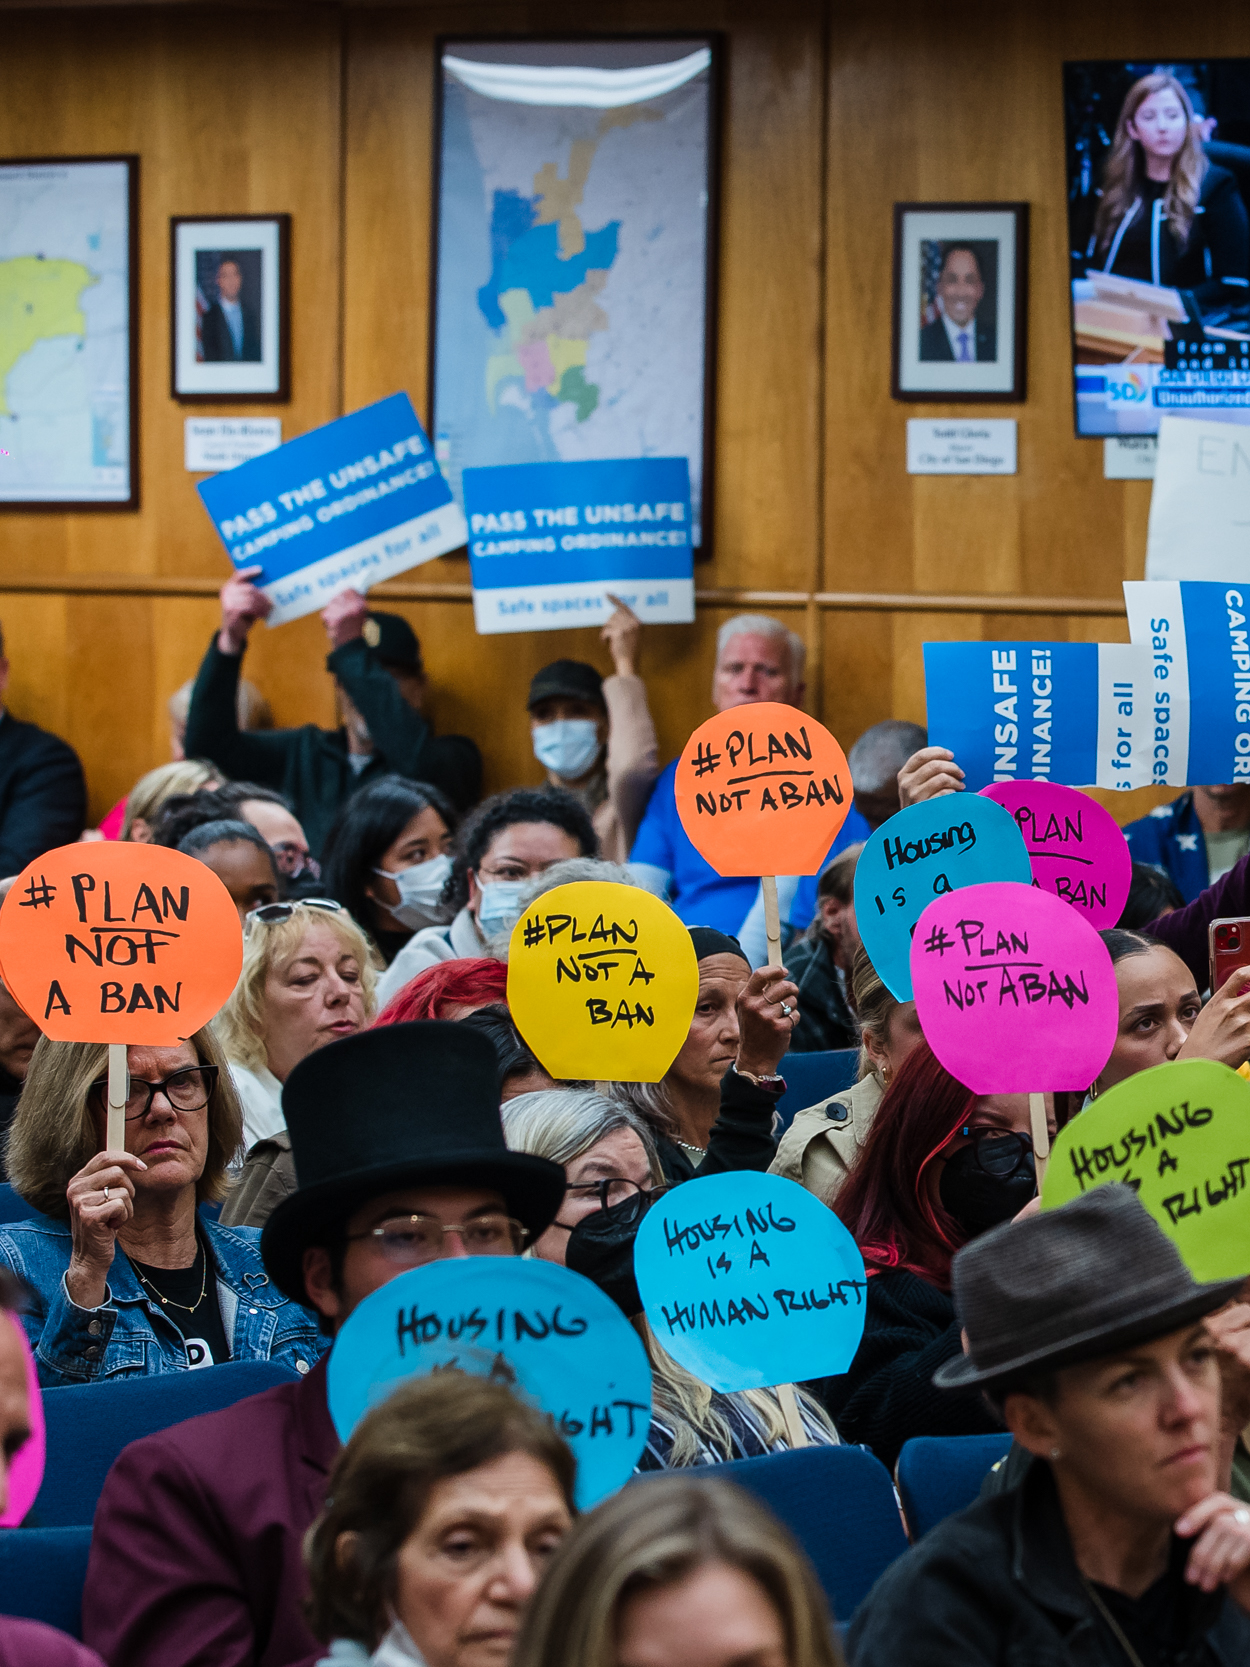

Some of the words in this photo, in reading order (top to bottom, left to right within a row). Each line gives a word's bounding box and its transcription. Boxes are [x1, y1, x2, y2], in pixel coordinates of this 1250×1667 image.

[1176, 356, 1214, 371] and
[1177, 339, 1227, 354] from
[221, 501, 278, 540] PASS
[278, 478, 328, 511] THE
[329, 434, 426, 489] UNSAFE
[231, 514, 315, 562] CAMPING
[316, 460, 437, 524] ORDINANCE!
[471, 510, 528, 535] PASS
[532, 505, 580, 528] THE
[584, 502, 686, 525] UNSAFE
[418, 522, 442, 545] all
[472, 535, 557, 558] CAMPING
[560, 529, 688, 552] ORDINANCE!
[498, 598, 536, 617] Safe
[646, 591, 670, 607] all
[1150, 617, 1175, 682] Safe
[1112, 682, 1134, 717] all
[1111, 727, 1133, 770] for
[695, 789, 751, 817] NOT
[1001, 803, 1083, 844] PLAN
[883, 821, 977, 870] Housing
[1055, 876, 1106, 909] BAN
[65, 931, 171, 968] NOT
[556, 955, 620, 984] NOT
[628, 957, 656, 986] A
[44, 979, 72, 1020] A
[100, 980, 183, 1014] BAN
[585, 998, 655, 1030] BAN
[943, 978, 988, 1012] NOT
[1069, 1101, 1214, 1192] HOUSING
[1158, 1150, 1178, 1178] A
[1162, 1157, 1250, 1225] RIGHT
[663, 1202, 796, 1257] HOUSING
[707, 1251, 732, 1280] IS
[749, 1239, 771, 1269] A
[661, 1293, 770, 1336] HUMAN
[773, 1279, 869, 1317] RIGHT
[396, 1303, 588, 1359] HOUSING
[547, 1399, 649, 1438] GHT
